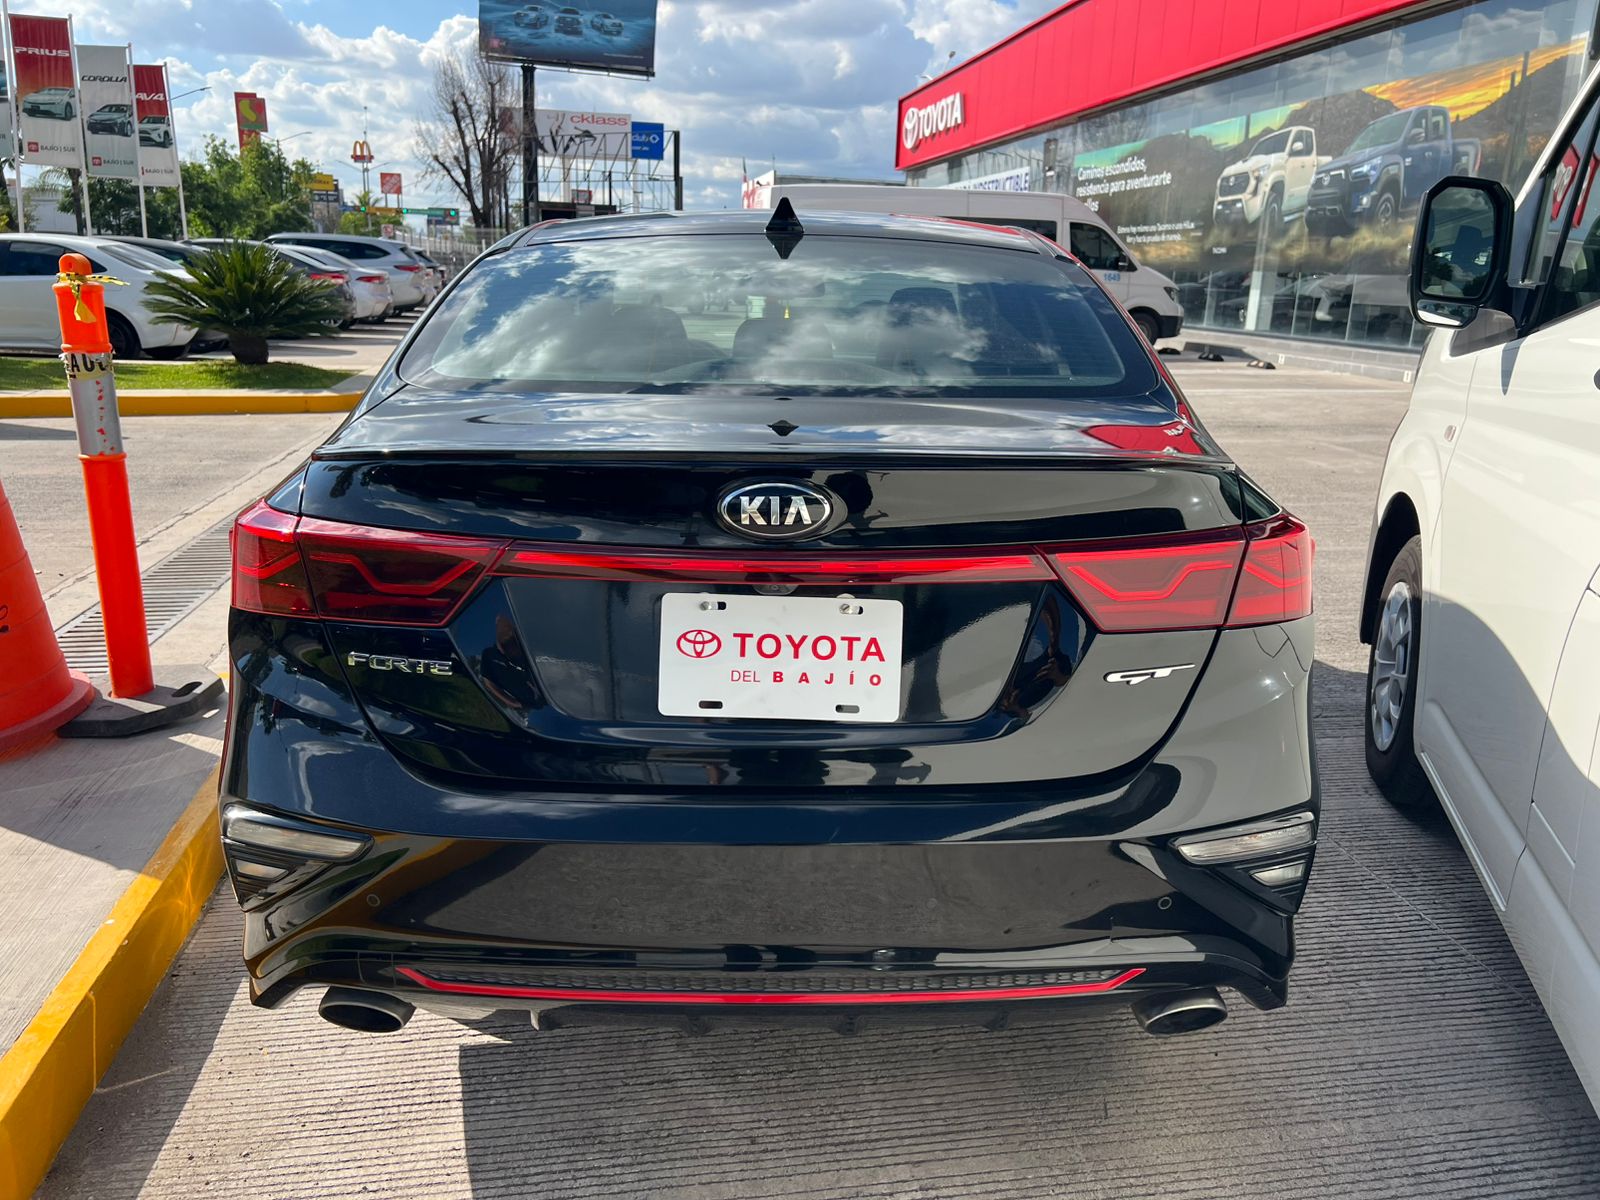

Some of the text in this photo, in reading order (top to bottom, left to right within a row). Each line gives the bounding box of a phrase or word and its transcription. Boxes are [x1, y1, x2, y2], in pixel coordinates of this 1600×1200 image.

[14, 46, 71, 57] PRIUS
[81, 75, 128, 83] COROLLA
[135, 92, 166, 102] AV4
[570, 113, 628, 126] cklass
[918, 92, 963, 139] TOYOTA
[1077, 156, 1147, 181] Caminos escondidos,
[1076, 170, 1172, 197] resistencia para aventurarte
[738, 495, 812, 526] KIA
[732, 632, 886, 662] TOYOTA
[347, 650, 454, 677] FORTE
[1103, 662, 1196, 686] GT
[730, 667, 882, 687] DEL BAJÍO
